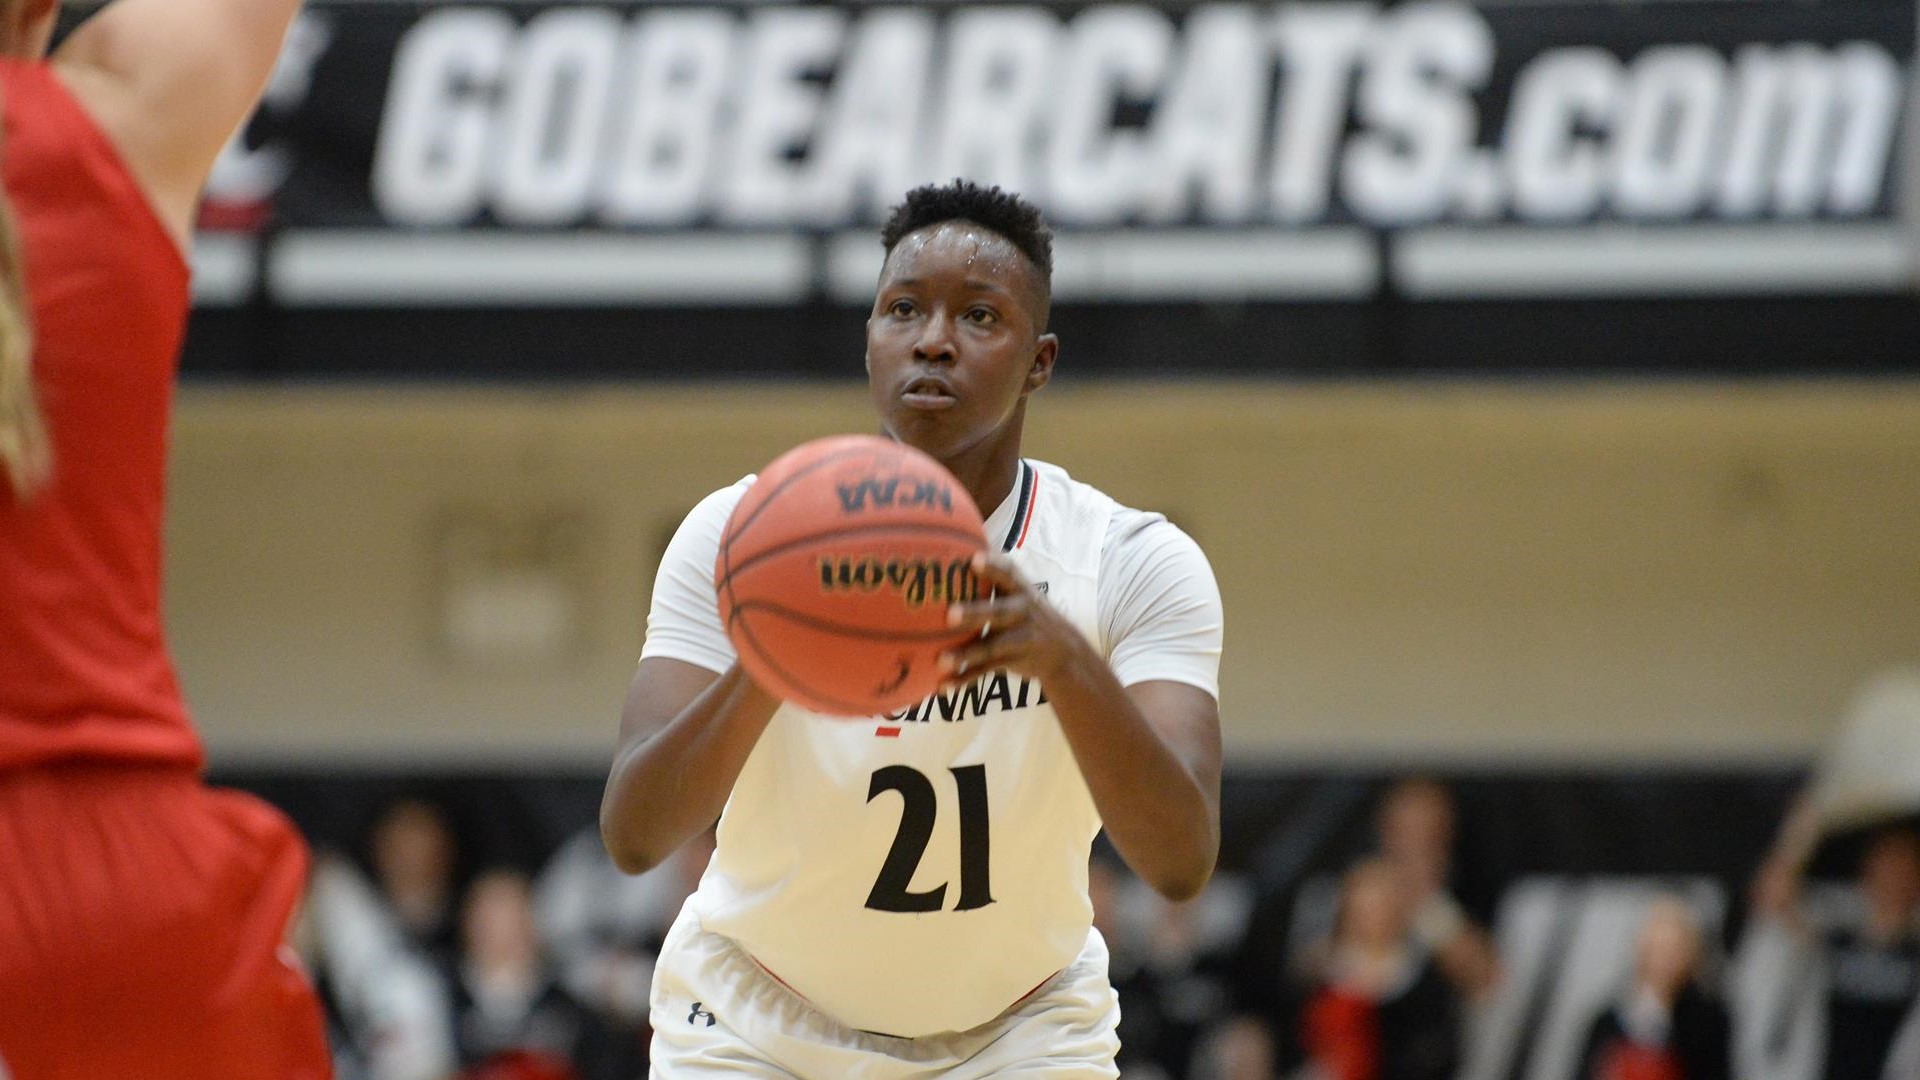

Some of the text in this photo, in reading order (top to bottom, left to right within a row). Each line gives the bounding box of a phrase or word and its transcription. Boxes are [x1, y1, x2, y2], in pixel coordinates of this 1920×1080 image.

[372, 4, 1898, 225] GOBEARCATS.com
[837, 478, 953, 516] NCAA
[818, 556, 979, 609] Wilson
[865, 763, 997, 913] 21
